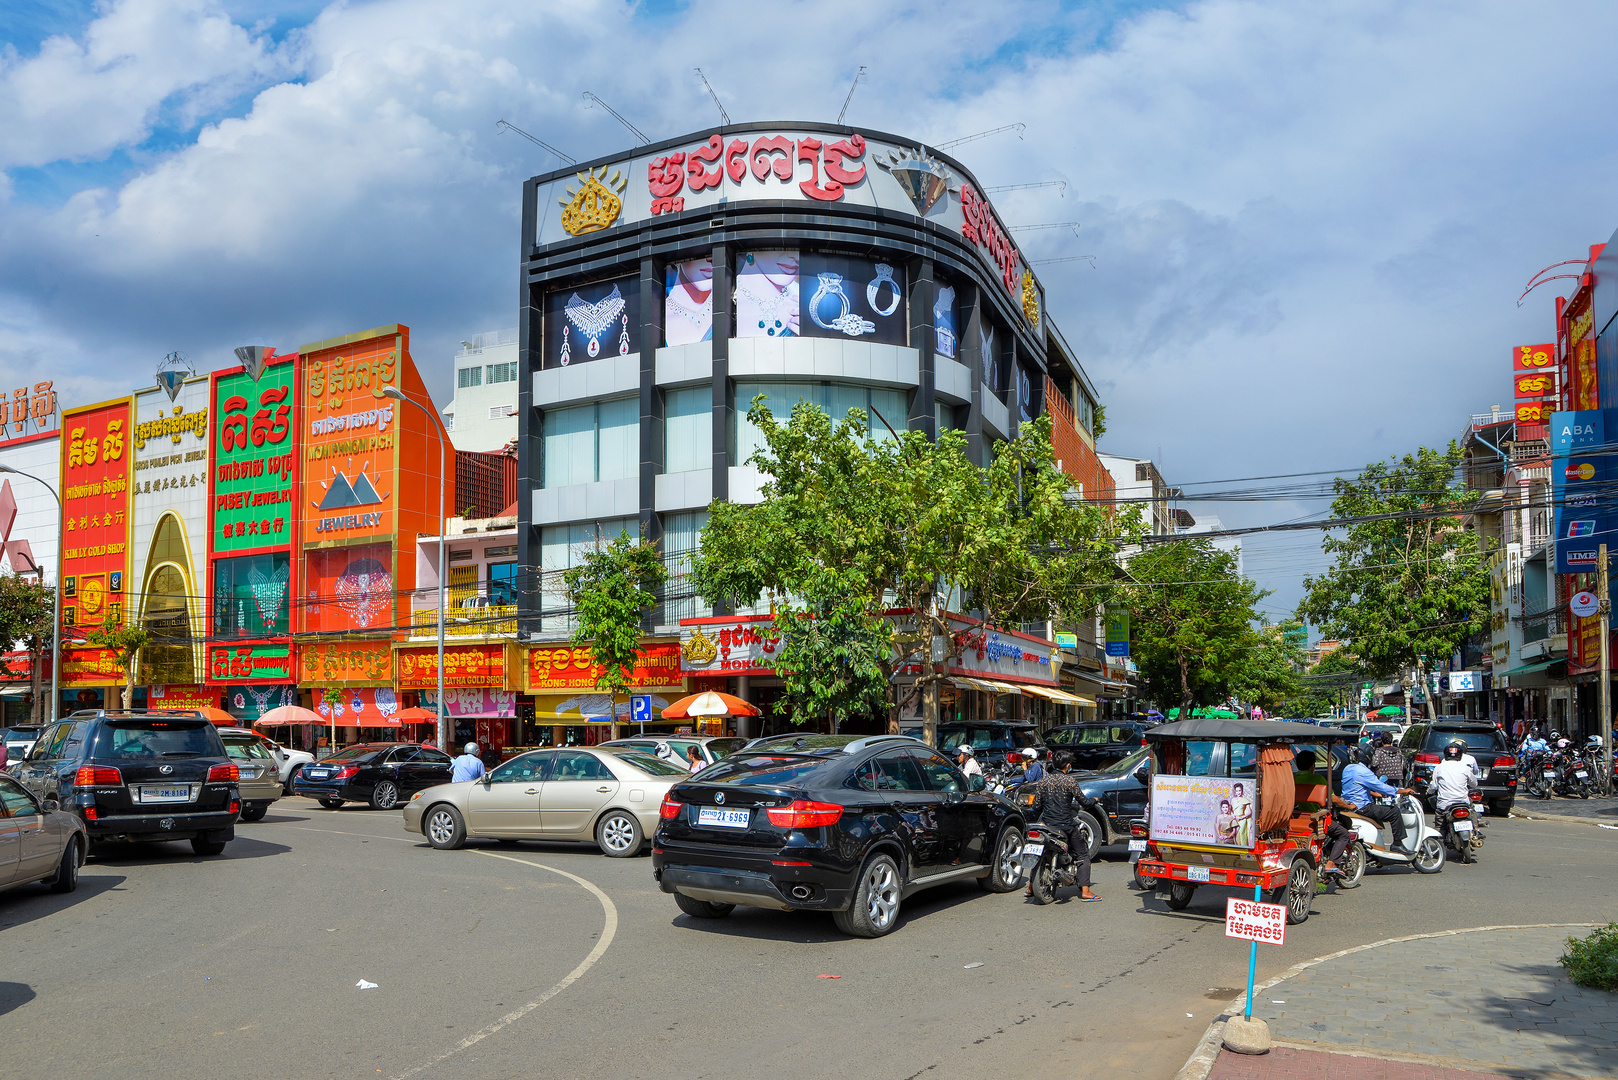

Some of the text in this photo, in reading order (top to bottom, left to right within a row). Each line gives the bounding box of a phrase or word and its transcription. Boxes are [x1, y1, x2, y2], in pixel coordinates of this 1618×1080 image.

[221, 385, 292, 452] ពិសី
[1561, 425, 1594, 436] ABA
[308, 433, 394, 461] MOM PHNOM PICH
[1561, 436, 1594, 444] BANK
[216, 488, 292, 512] PISEY JEWELRY
[315, 511, 383, 533] JEWELRY
[64, 542, 125, 559] KIM LY GOLD SHOP
[1573, 552, 1596, 560] IME
[214, 647, 253, 678] ពិសី
[467, 676, 485, 684] GOLD
[541, 679, 566, 688] KONG
[569, 678, 594, 687] HONG
[643, 677, 669, 686] SHOP
[632, 698, 645, 719] P
